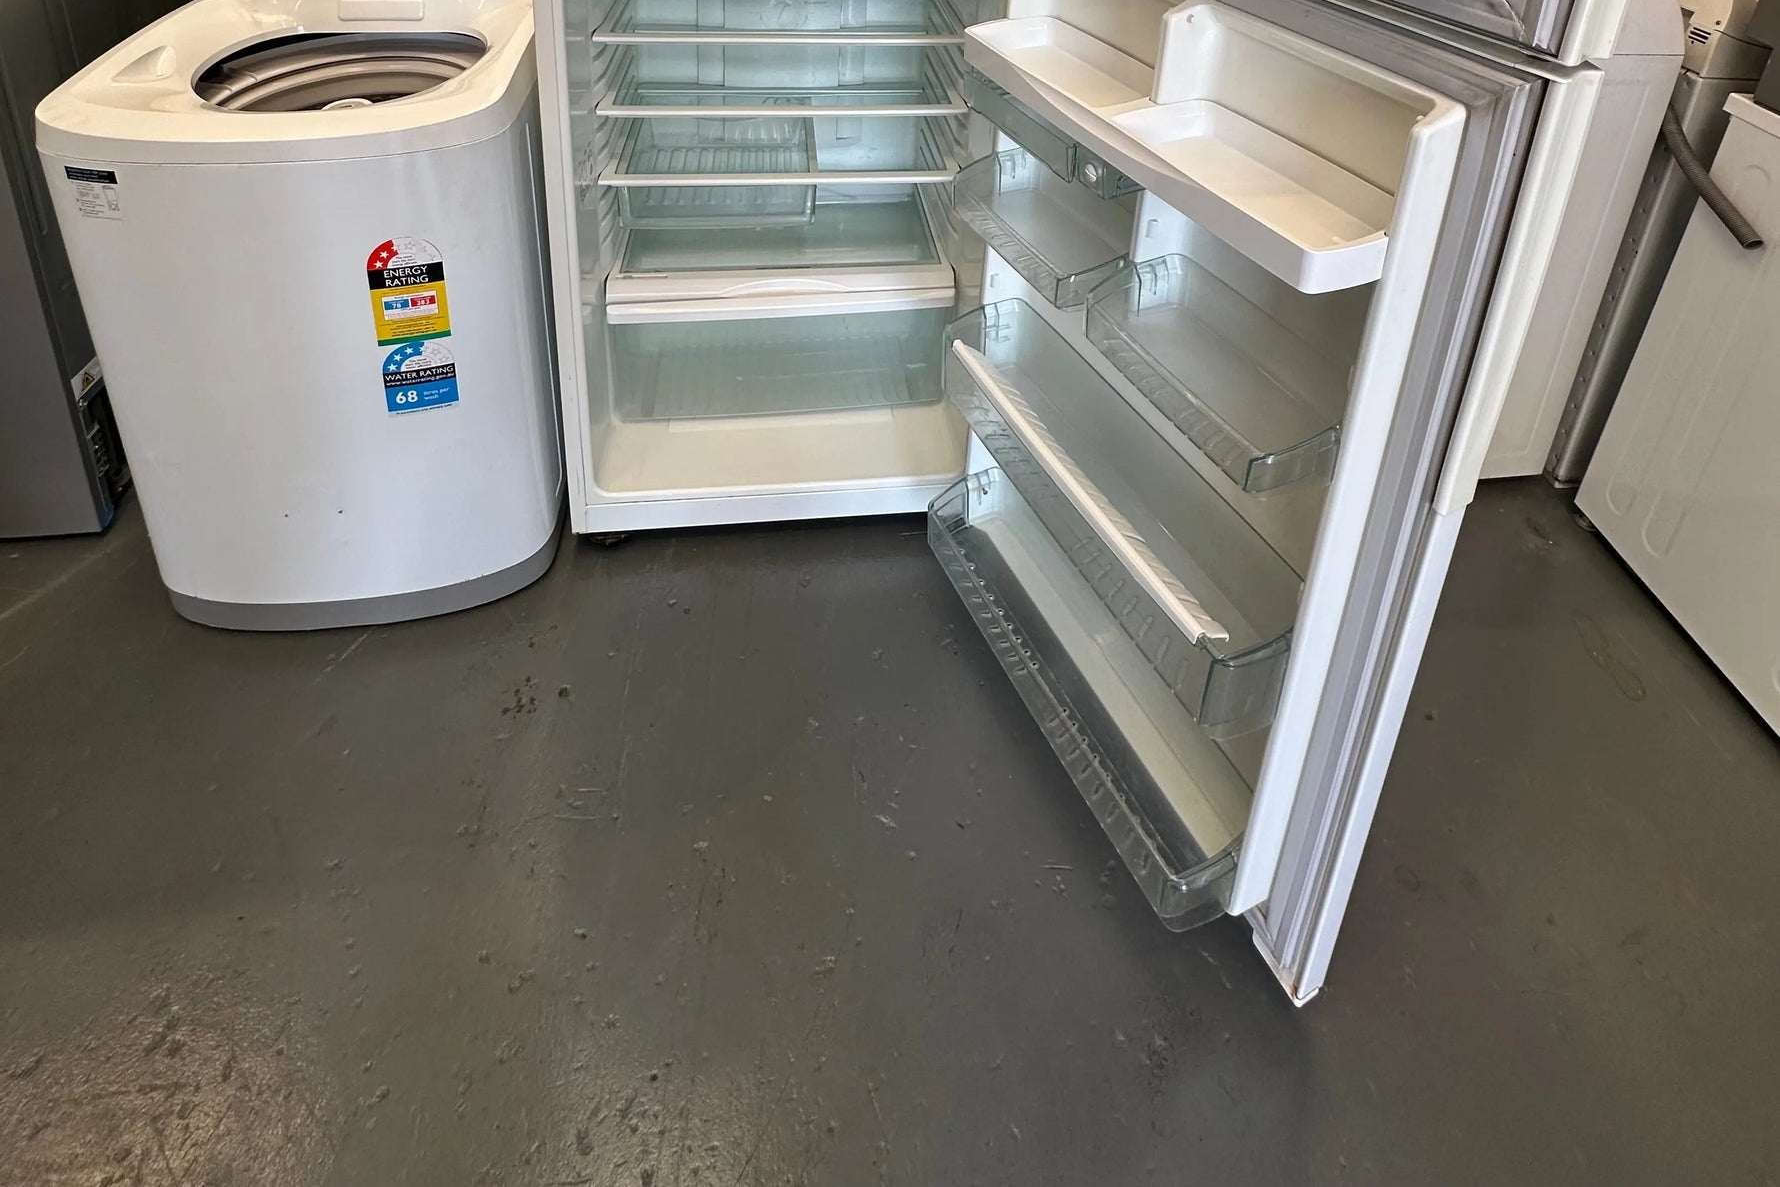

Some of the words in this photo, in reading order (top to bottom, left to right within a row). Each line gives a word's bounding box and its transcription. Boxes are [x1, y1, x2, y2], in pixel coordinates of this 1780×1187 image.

[383, 265, 427, 278] ENERGY
[385, 275, 429, 287] RATING
[385, 373, 418, 381] WATER
[420, 365, 454, 376] RATING
[396, 390, 418, 404] 68
